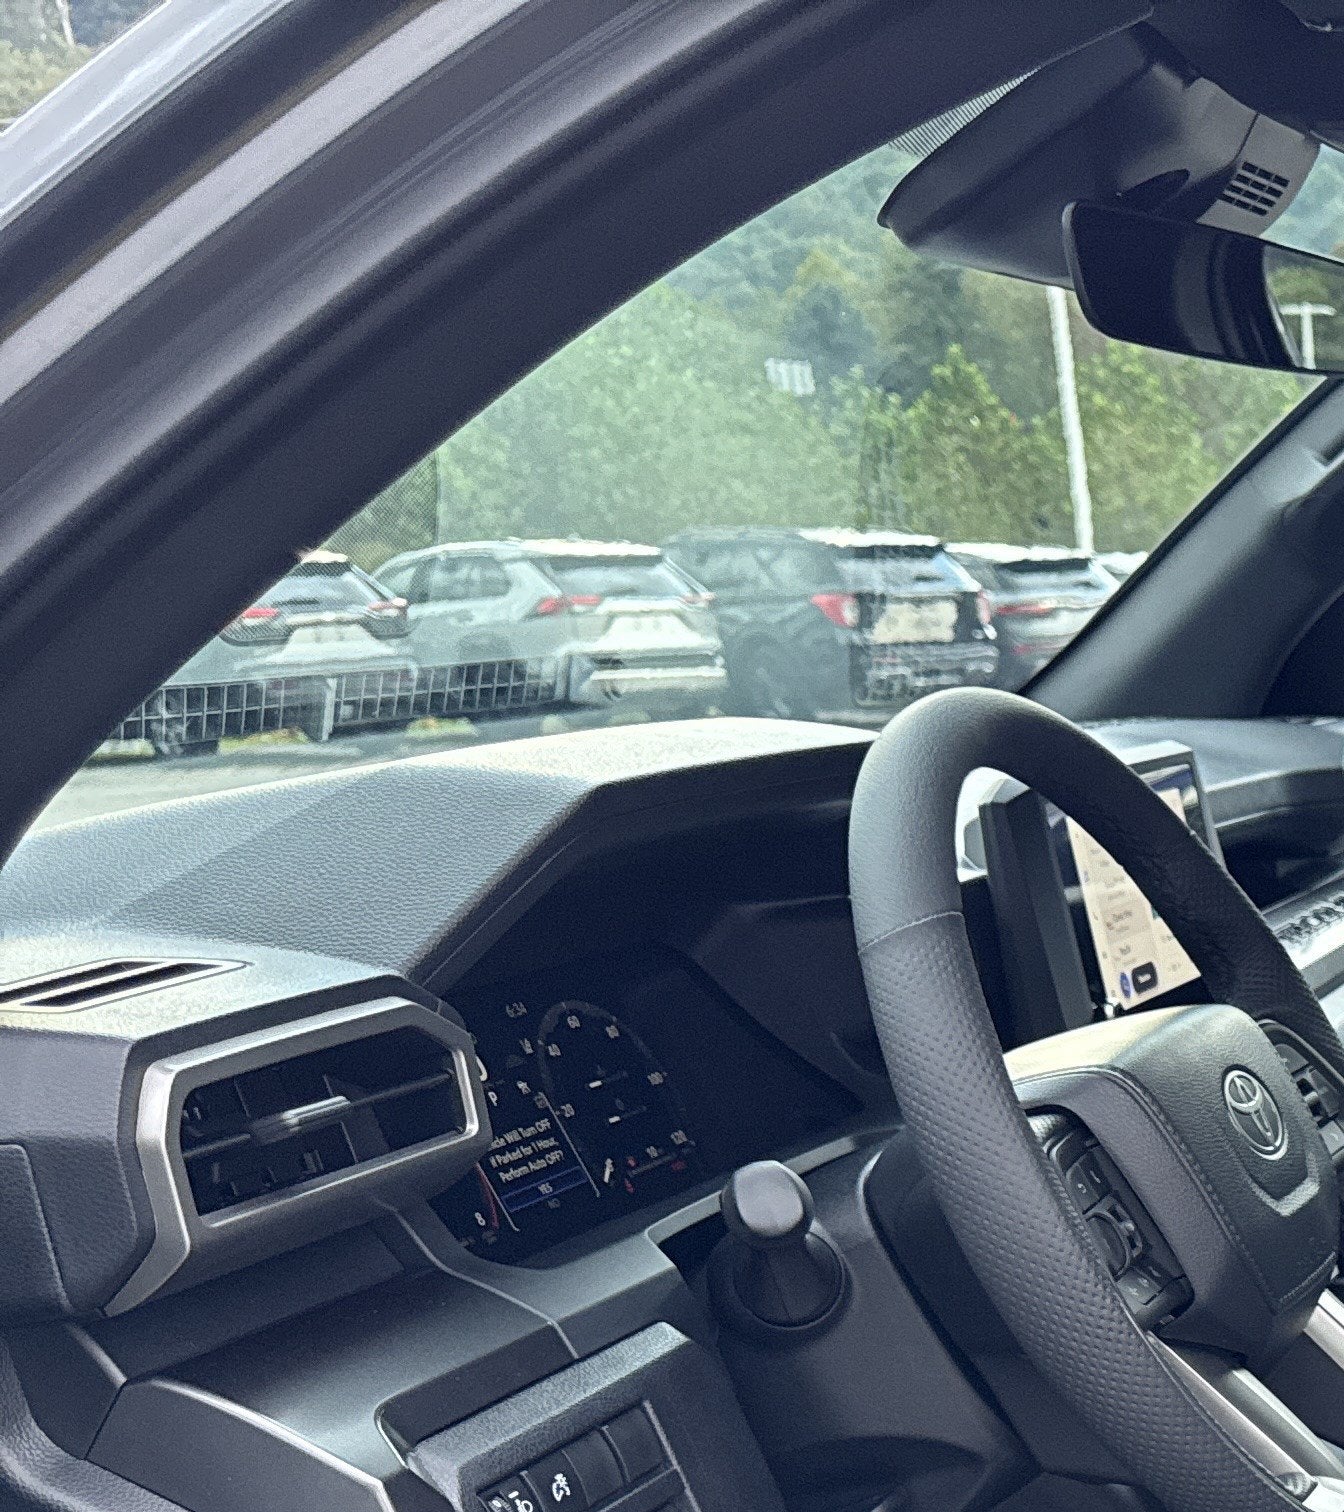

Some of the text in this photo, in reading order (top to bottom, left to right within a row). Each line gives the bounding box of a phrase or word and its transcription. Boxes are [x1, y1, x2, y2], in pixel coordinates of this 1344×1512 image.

[535, 1118, 551, 1133] OFF
[496, 1146, 523, 1166] Parked
[520, 1144, 534, 1157] for
[498, 1165, 531, 1183] Perform
[528, 1158, 548, 1173] Auto
[538, 1182, 553, 1195] YES
[474, 1211, 486, 1226] 8
